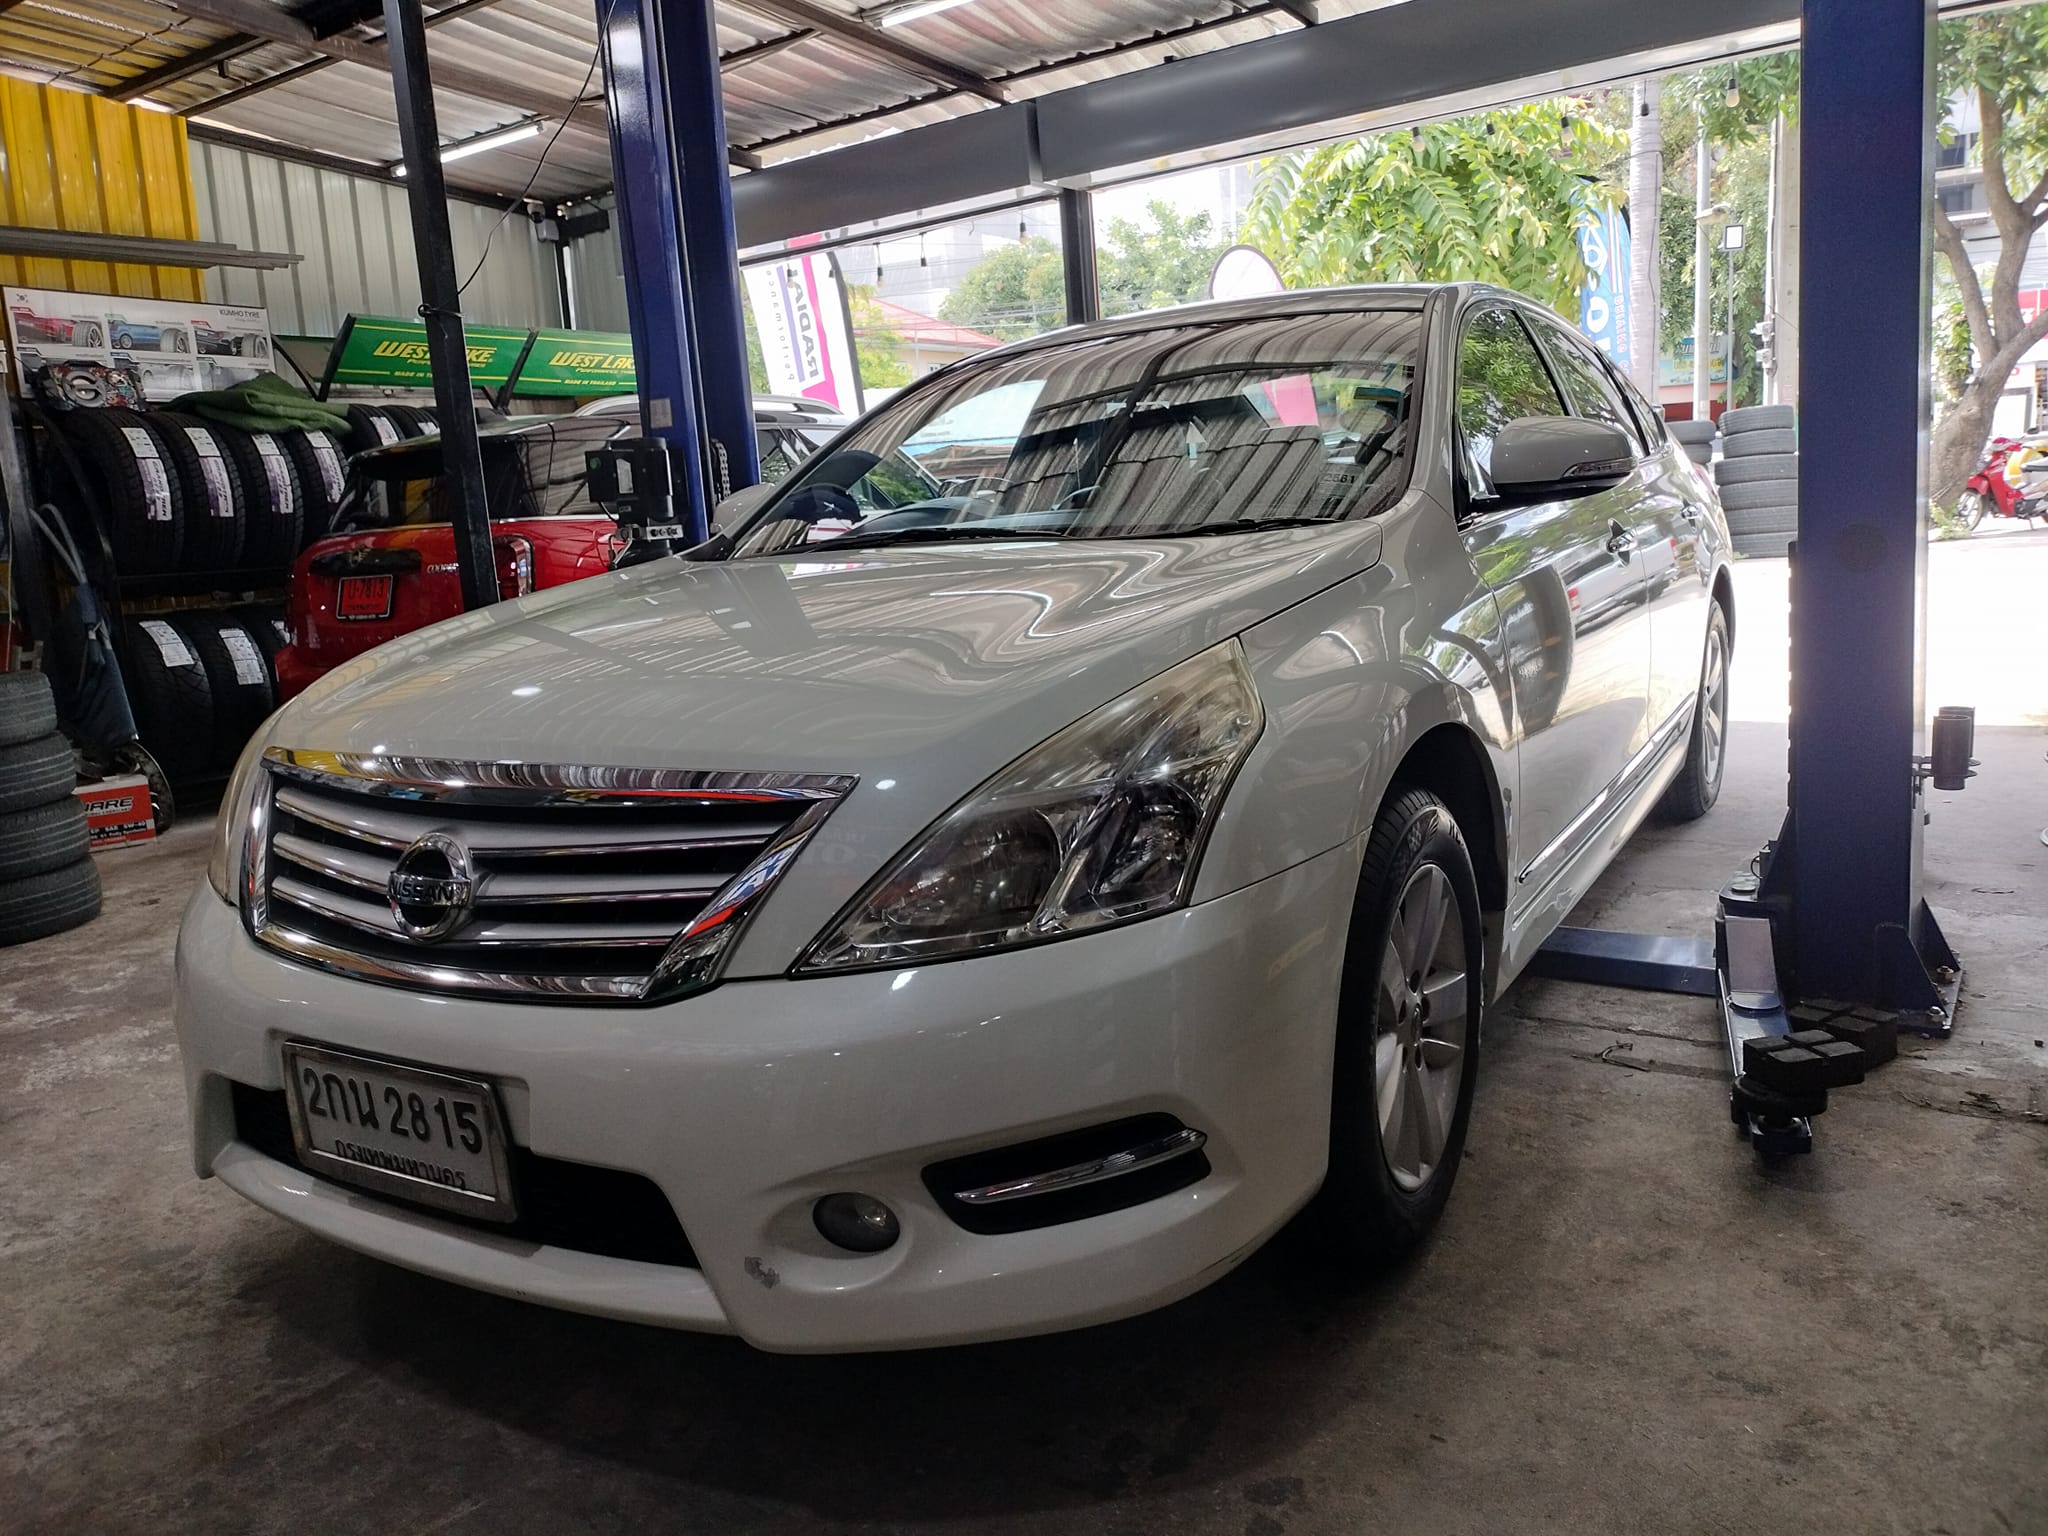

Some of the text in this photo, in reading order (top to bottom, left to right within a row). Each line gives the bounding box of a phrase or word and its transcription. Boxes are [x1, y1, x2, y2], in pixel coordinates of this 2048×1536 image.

[373, 341, 431, 359] WES
[549, 352, 635, 369] WEST LAK
[303, 1067, 483, 1154] 2กน 2815
